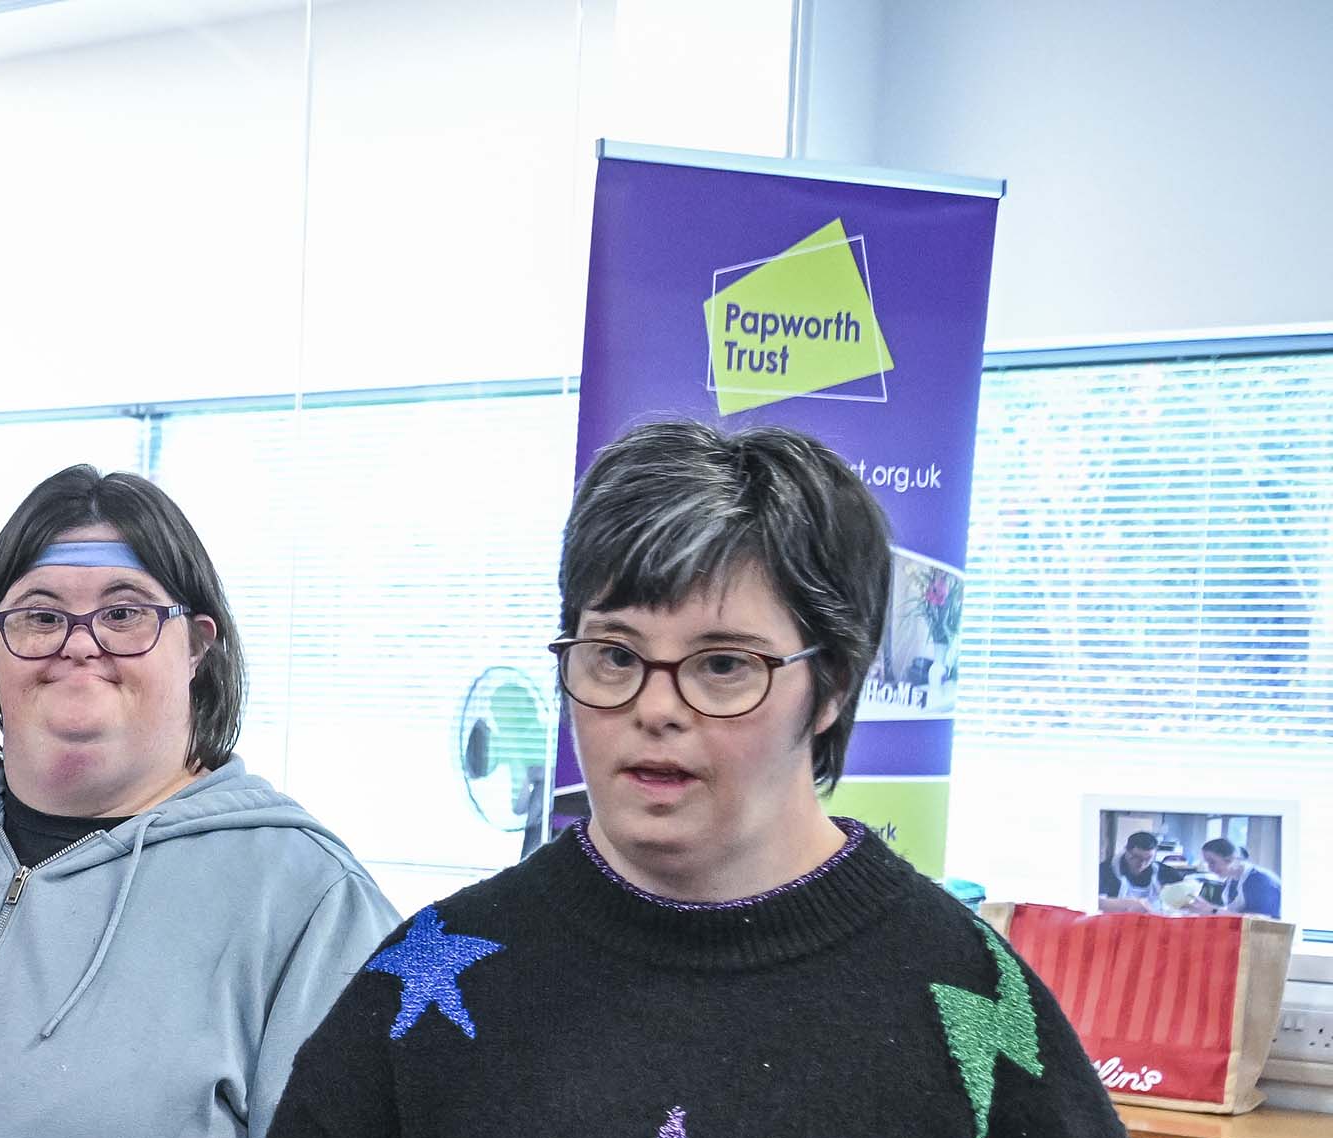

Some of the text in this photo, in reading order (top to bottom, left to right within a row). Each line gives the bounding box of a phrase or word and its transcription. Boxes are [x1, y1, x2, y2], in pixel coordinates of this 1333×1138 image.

[725, 302, 860, 344] Papworth
[724, 340, 789, 376] Trust
[1093, 1056, 1163, 1092] lin's
